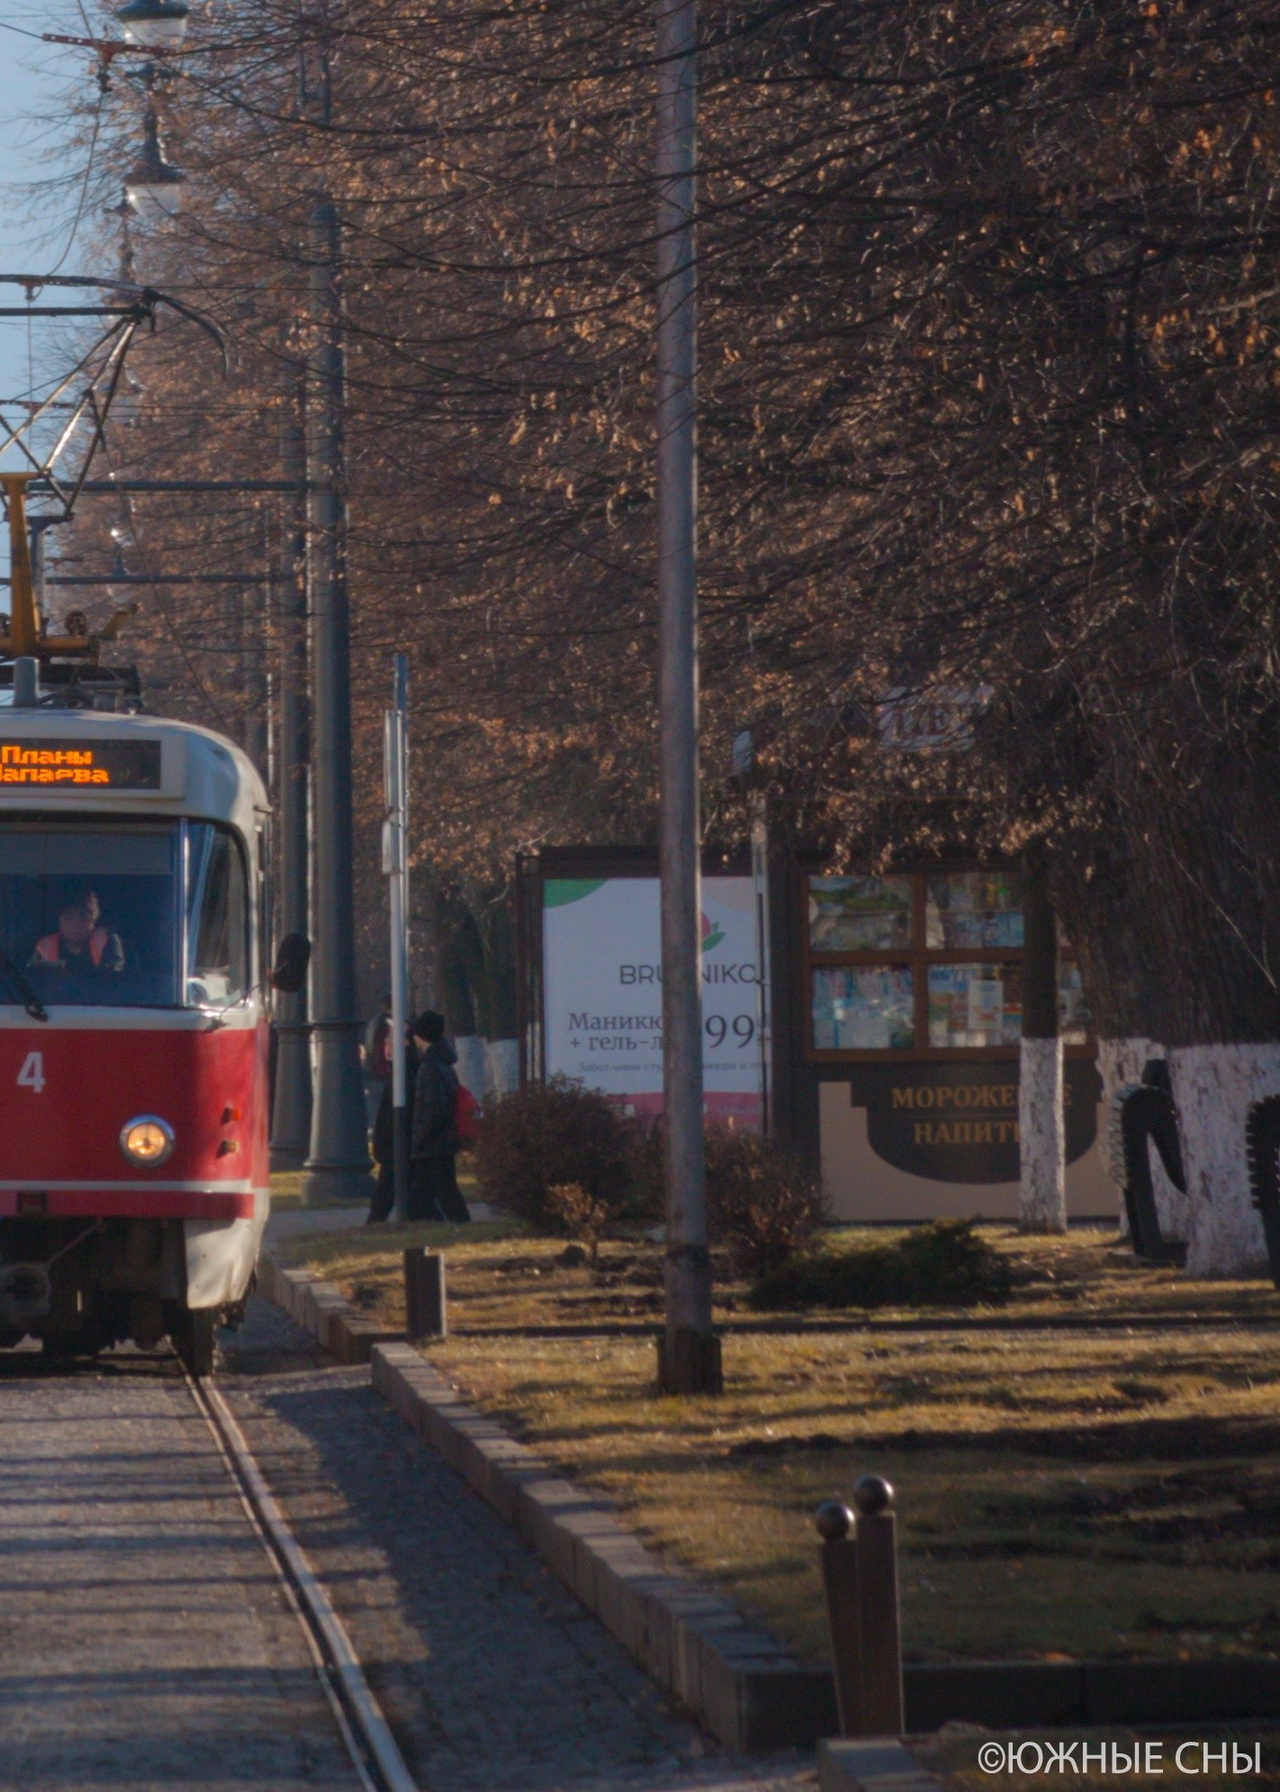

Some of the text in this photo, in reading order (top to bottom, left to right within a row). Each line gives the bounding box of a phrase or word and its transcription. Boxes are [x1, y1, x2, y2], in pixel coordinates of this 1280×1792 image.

[1, 745, 93, 765] Планы
[567, 1012, 663, 1031] Маникю
[16, 1051, 46, 1094] 4
